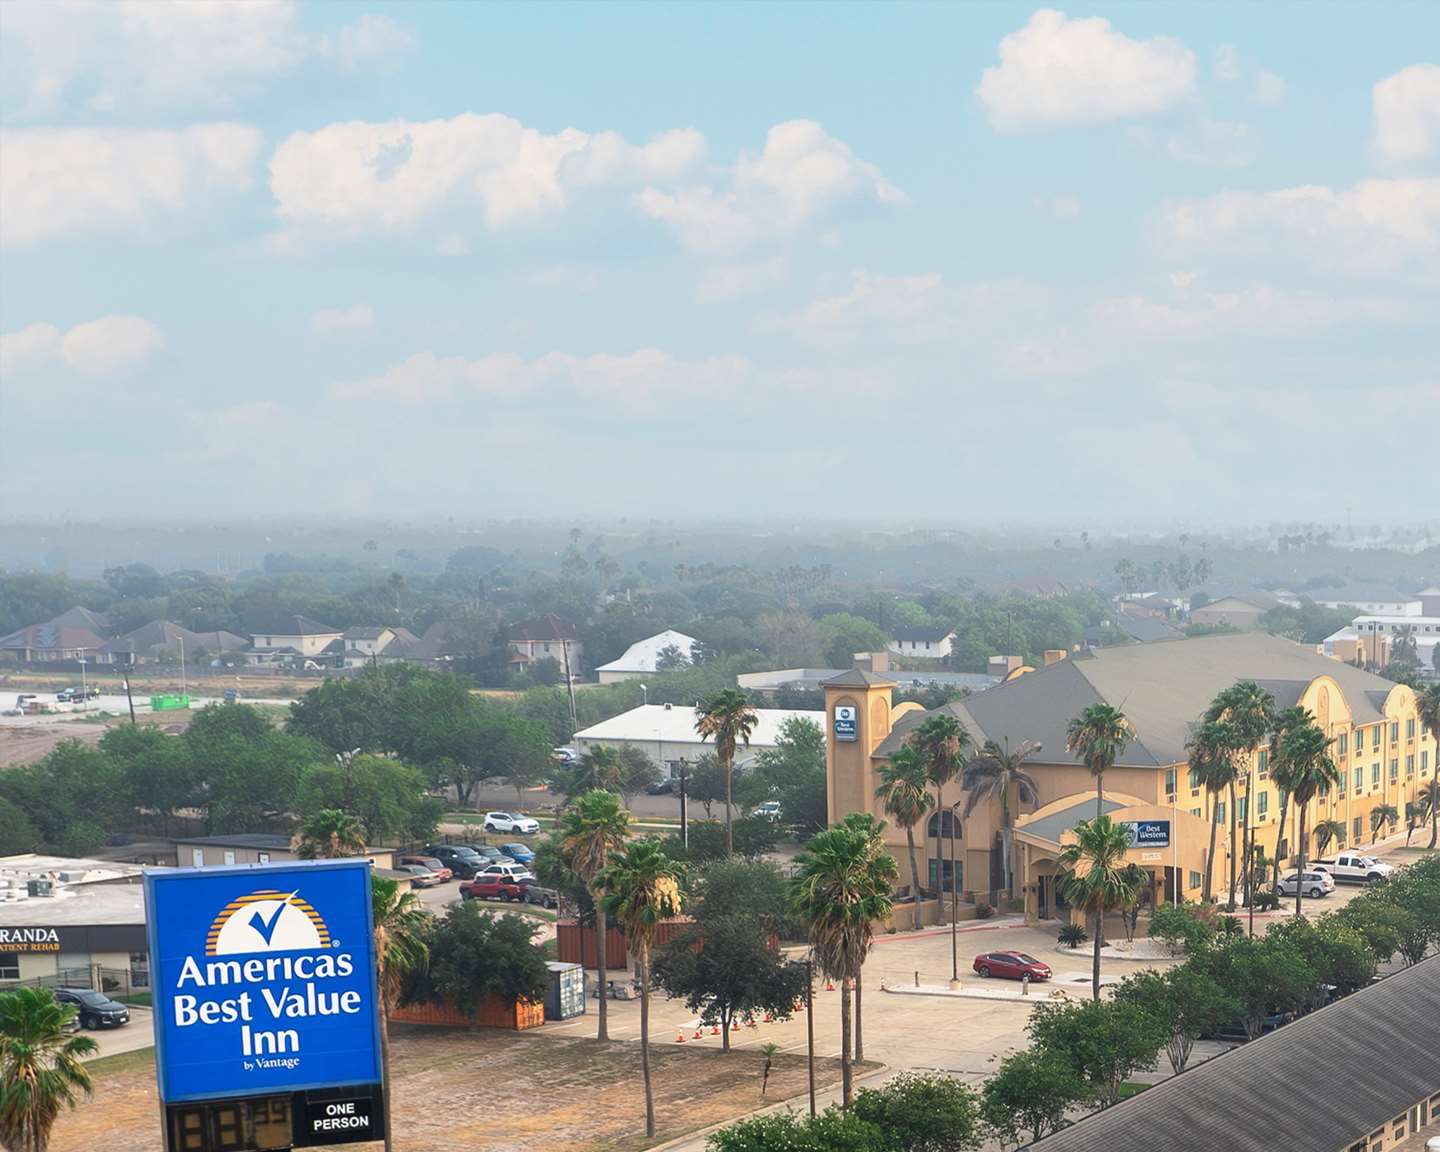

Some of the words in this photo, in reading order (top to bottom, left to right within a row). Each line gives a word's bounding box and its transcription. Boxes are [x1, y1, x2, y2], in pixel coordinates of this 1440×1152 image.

[31, 943, 60, 951] REHAB
[176, 953, 353, 988] Americas
[174, 991, 253, 1027] Best
[261, 982, 361, 1018] Value
[241, 1025, 300, 1056] Inn
[243, 1060, 255, 1072] by
[255, 1057, 300, 1070] Vantage
[325, 1103, 355, 1116] ONE
[314, 1116, 369, 1131] PERSON
